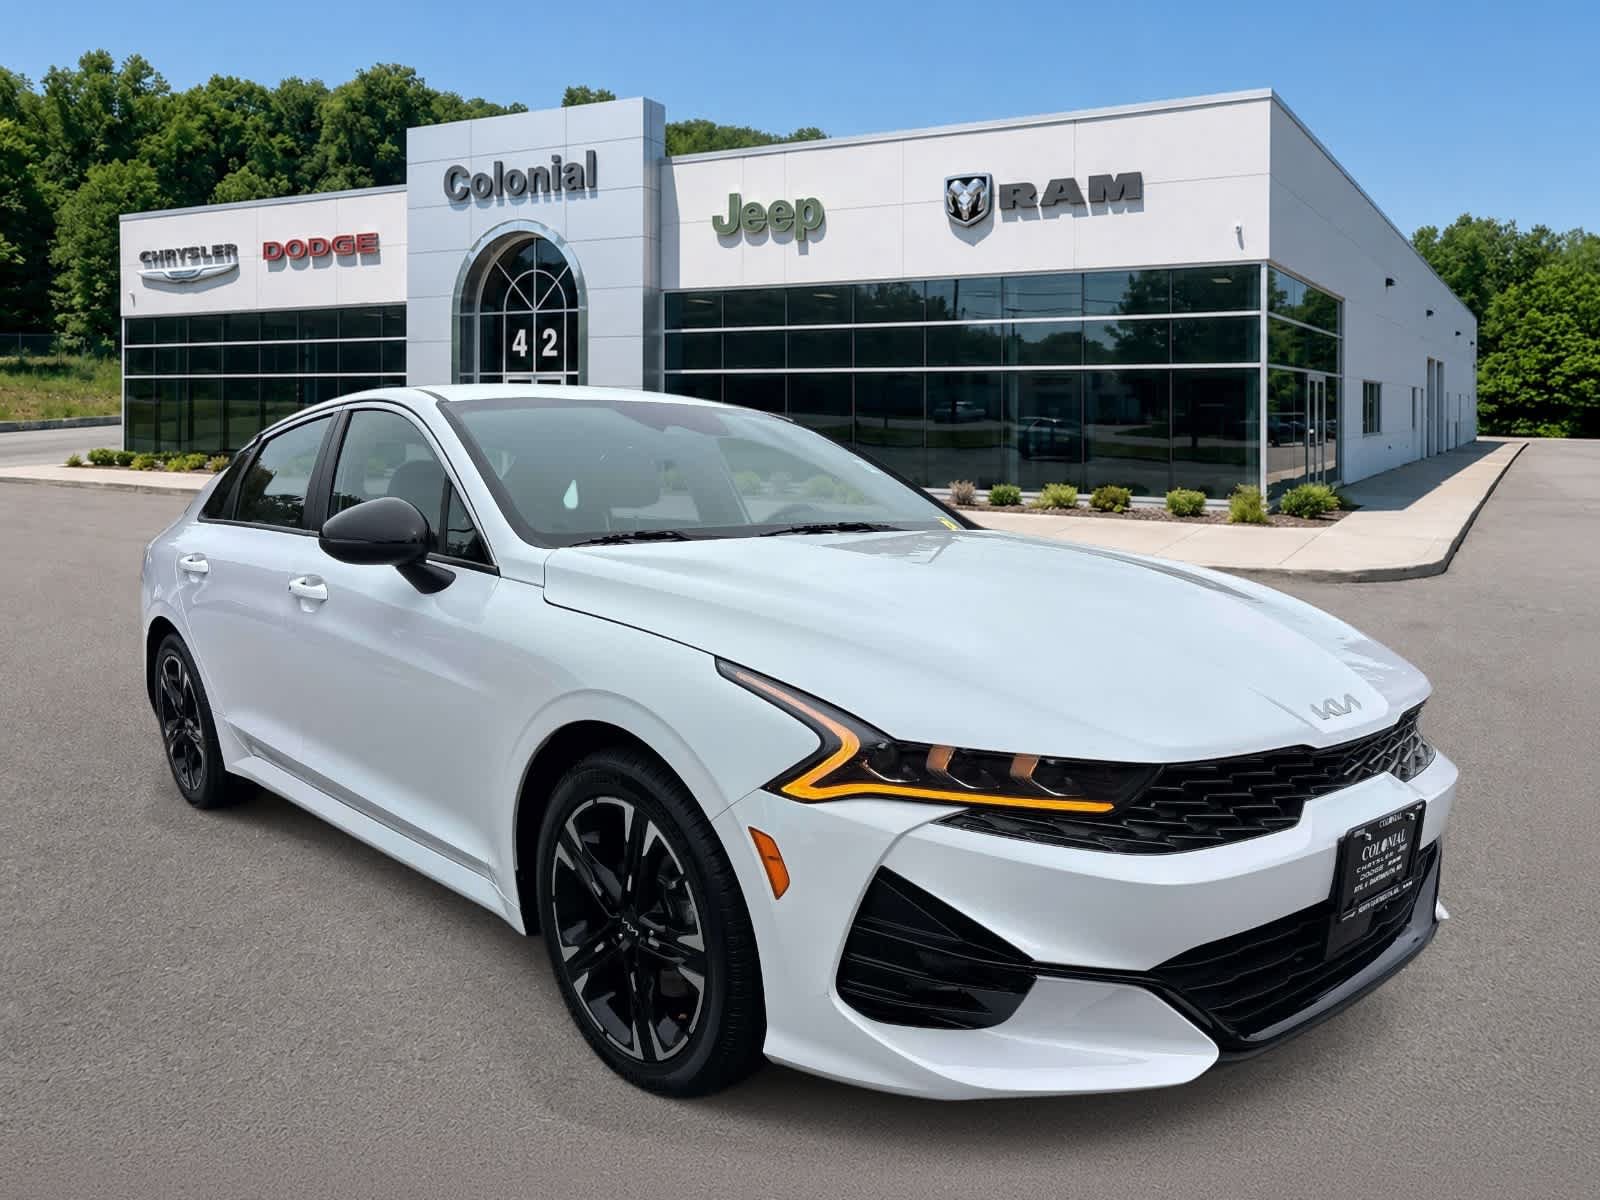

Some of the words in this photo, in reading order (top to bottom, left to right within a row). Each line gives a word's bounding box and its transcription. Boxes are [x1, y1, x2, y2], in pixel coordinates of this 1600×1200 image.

[443, 150, 597, 201] Colonial
[998, 172, 1144, 209] RAM
[712, 193, 825, 241] Jeep
[139, 243, 239, 263] CHRYSLER
[263, 232, 380, 261] DODGE
[1362, 829, 1407, 861] COLONIAL
